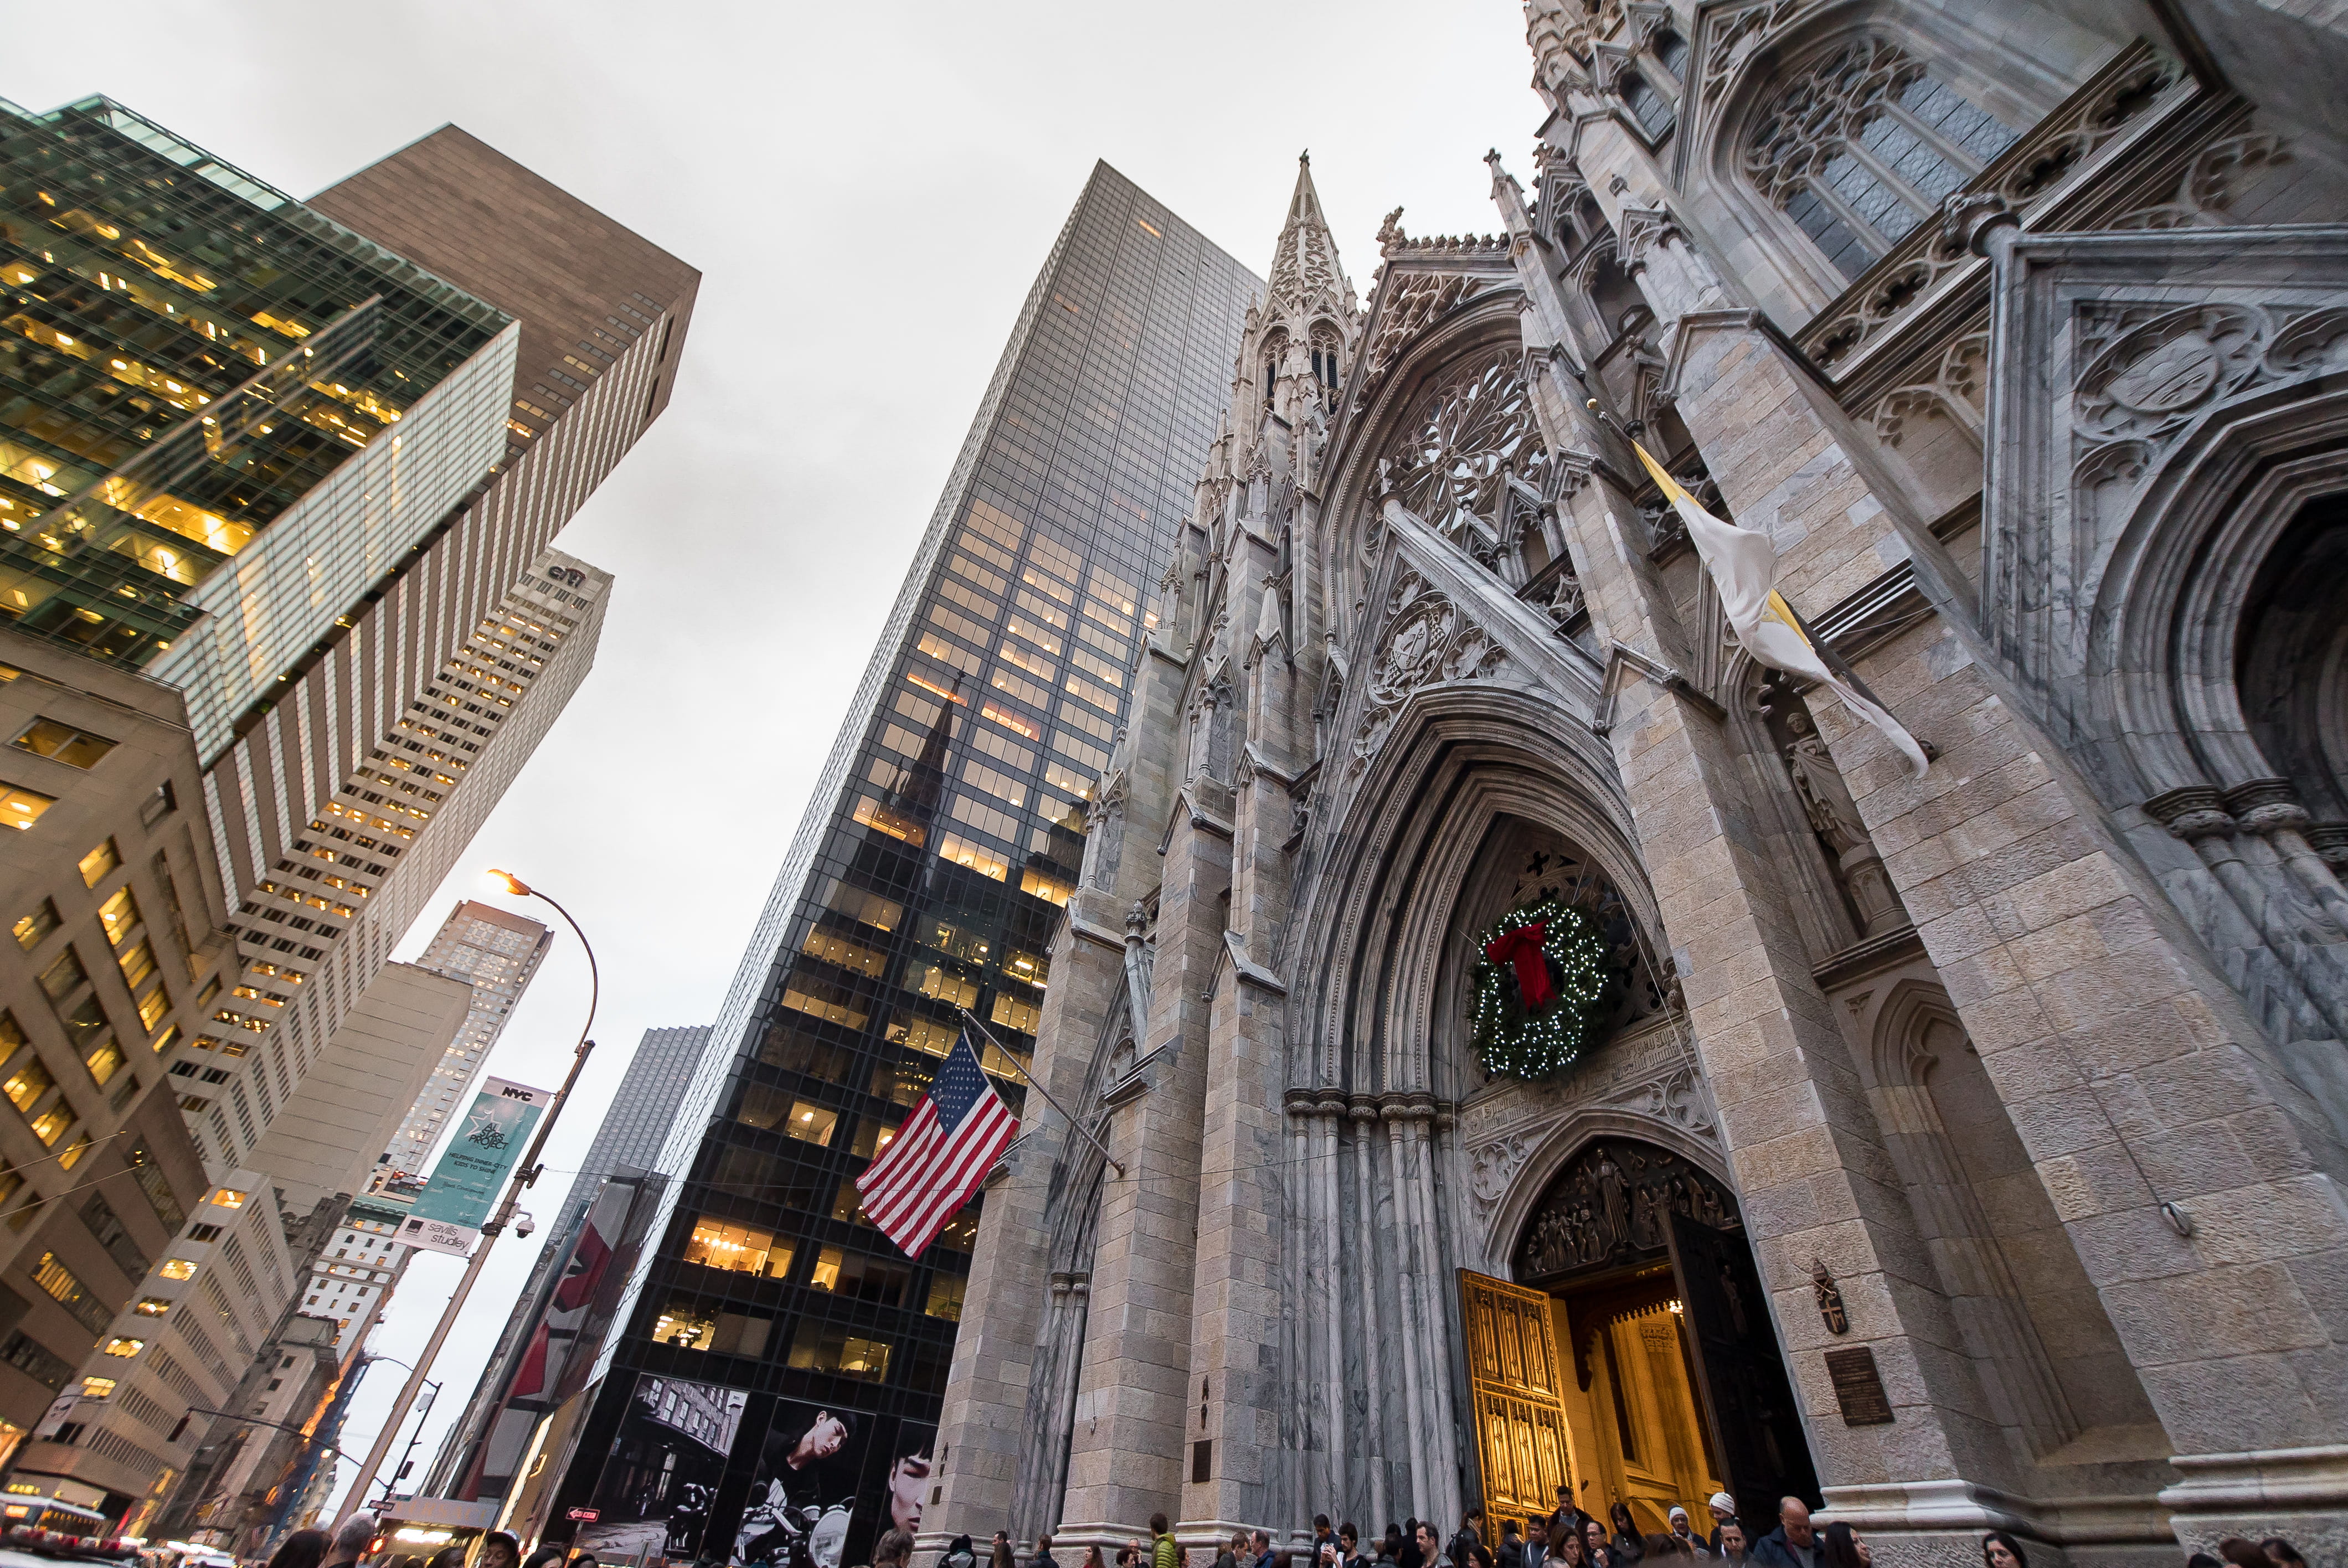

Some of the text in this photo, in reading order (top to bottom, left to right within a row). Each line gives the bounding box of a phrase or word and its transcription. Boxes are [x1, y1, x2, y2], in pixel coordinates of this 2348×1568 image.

[502, 1086, 533, 1102] NYC
[468, 1134, 509, 1149] PROJECT
[480, 1130, 505, 1141] STARS
[449, 1152, 508, 1170] HELPING INNER-CITY
[428, 1223, 459, 1236] savills
[430, 1234, 470, 1250] studley
